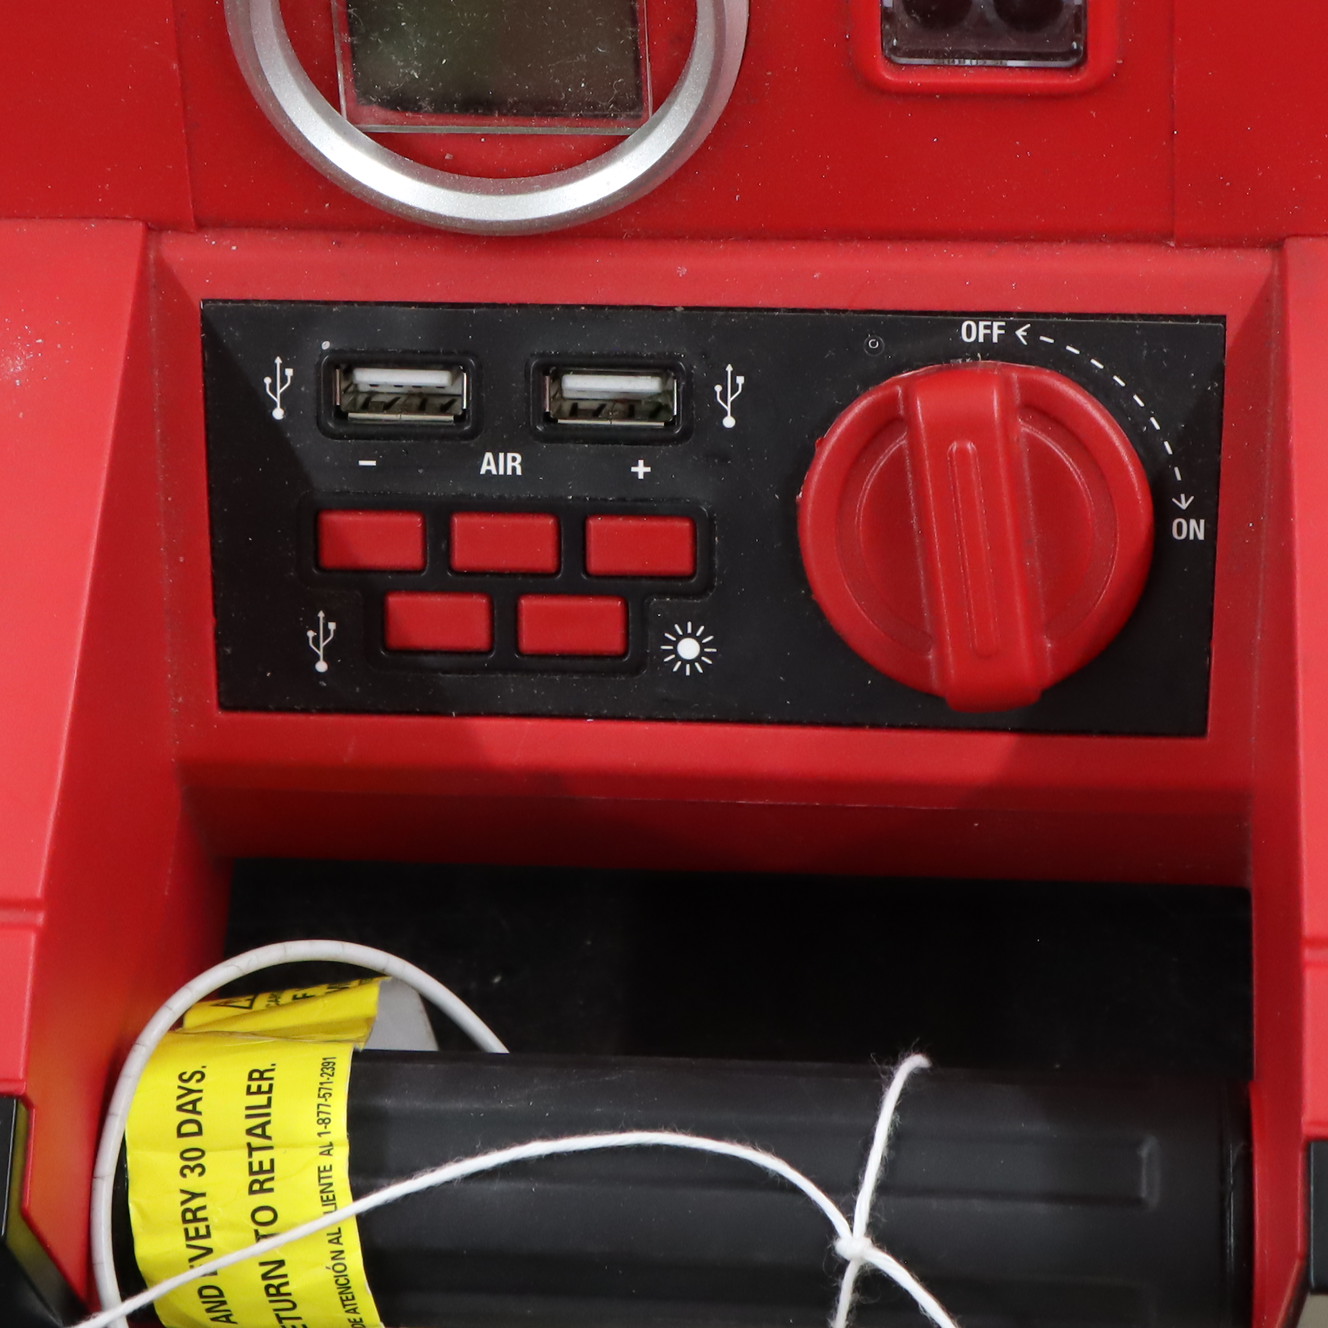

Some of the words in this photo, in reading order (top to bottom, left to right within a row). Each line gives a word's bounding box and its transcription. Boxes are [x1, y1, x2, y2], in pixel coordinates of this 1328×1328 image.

[960, 320, 1007, 344] OFF
[479, 451, 524, 477] AIR
[1171, 518, 1206, 541] ON
[175, 1064, 208, 1140] DAYS.
[316, 1056, 337, 1137] 1-877-571-2391
[244, 1062, 277, 1197] RETAILER.
[319, 1140, 334, 1157] AL
[179, 1147, 207, 1179] 30
[317, 1164, 339, 1215] LIENTE
[179, 1188, 219, 1277] VERY
[326, 1227, 343, 1247] AL
[325, 1249, 361, 1316] ATENCIÓN
[197, 1284, 239, 1325] AND
